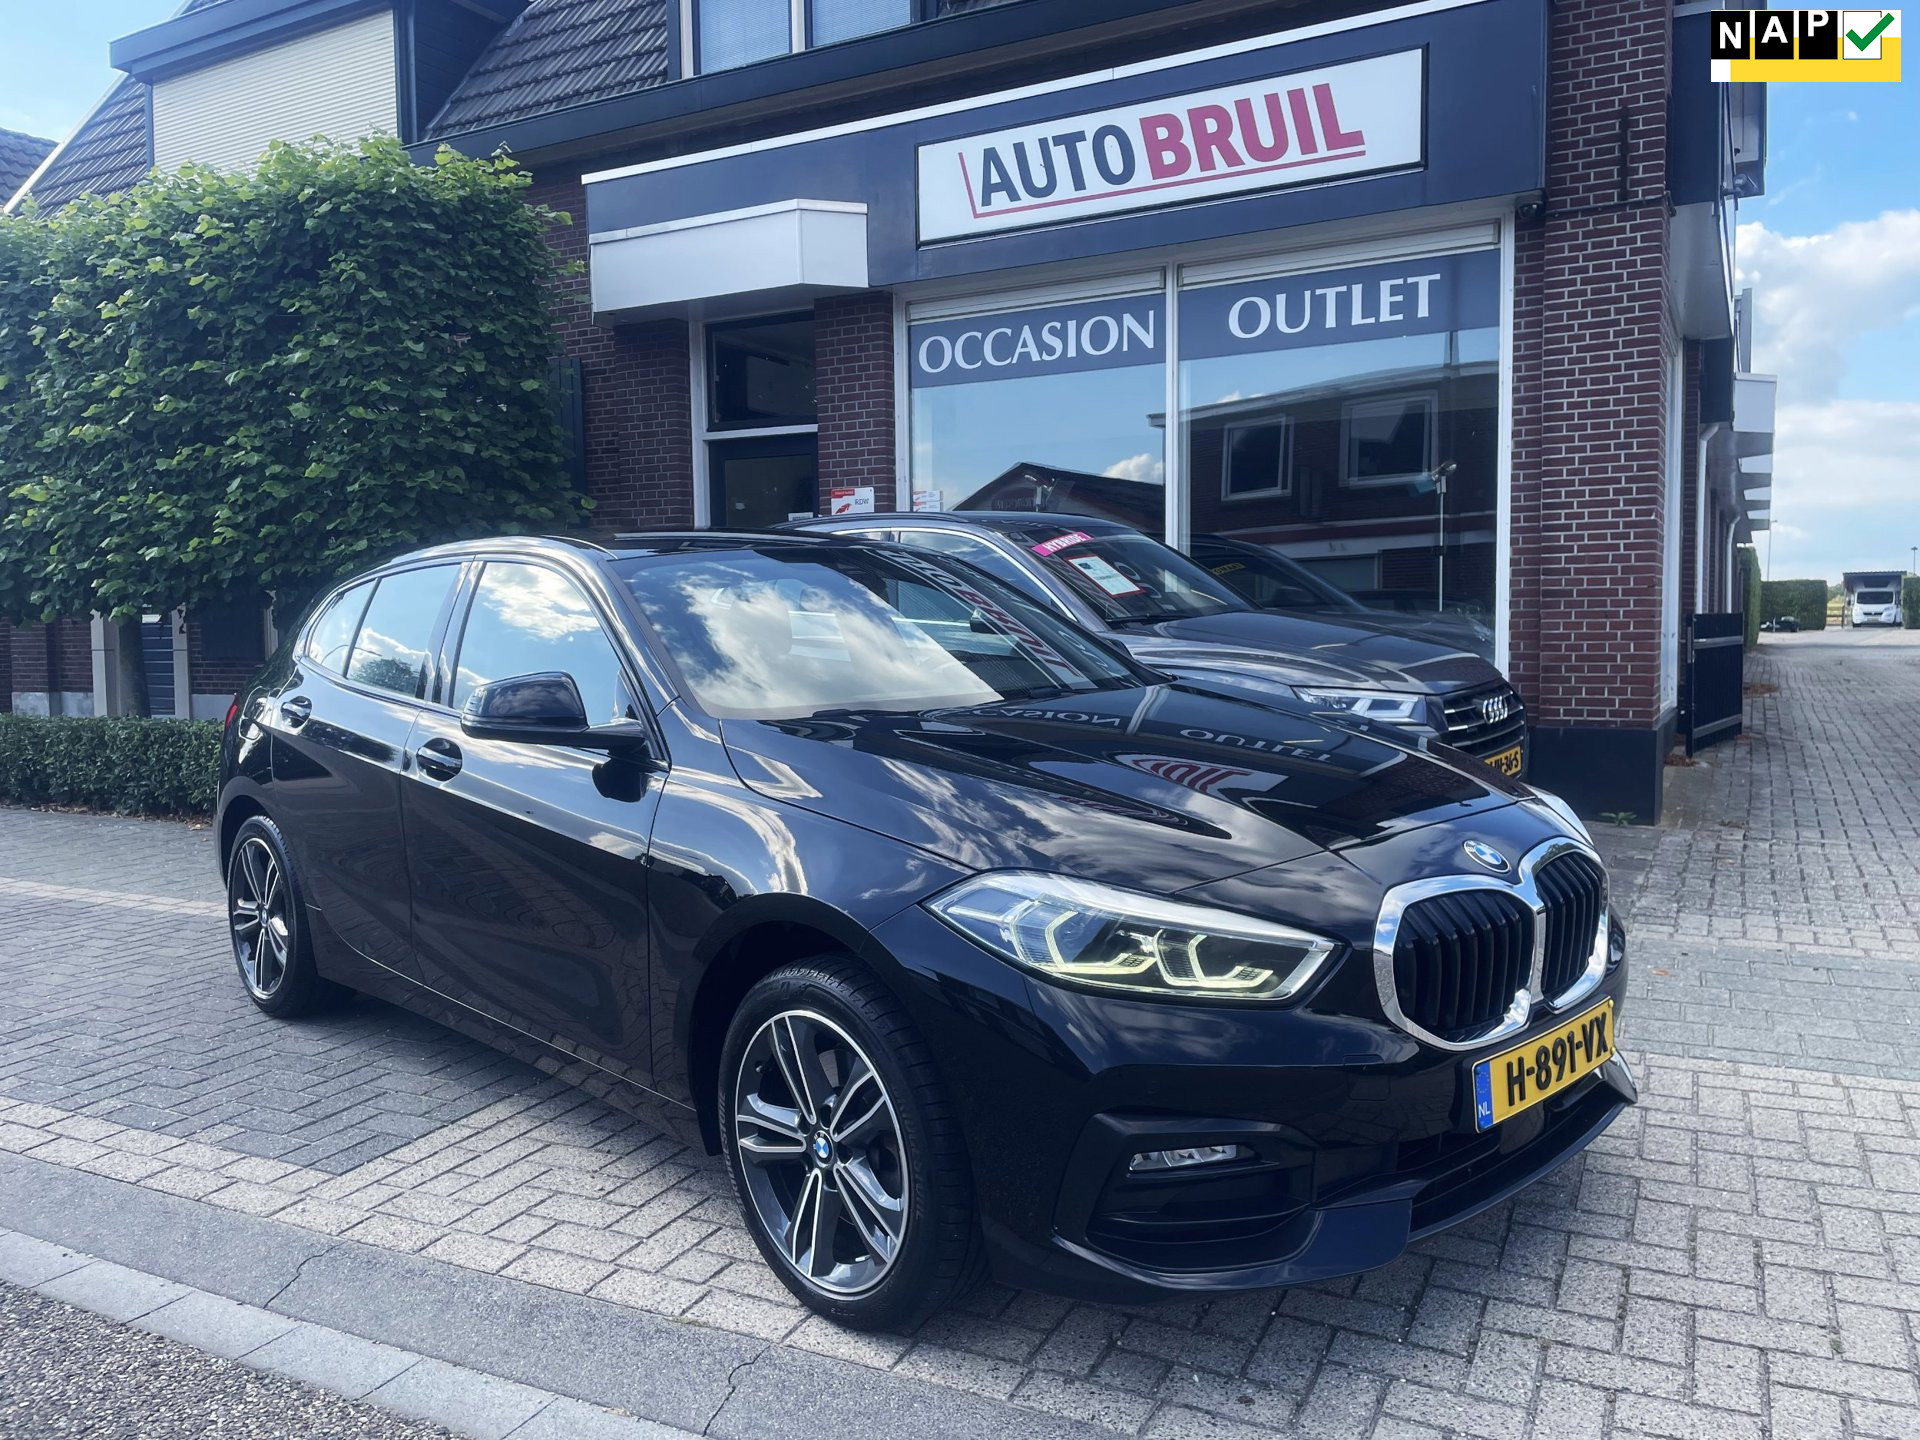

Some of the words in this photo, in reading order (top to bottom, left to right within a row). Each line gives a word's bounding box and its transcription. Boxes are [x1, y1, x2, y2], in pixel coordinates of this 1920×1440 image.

[918, 310, 1156, 374] OCCASION
[1228, 273, 1441, 338] OUTLET
[1507, 1012, 1609, 1107] H-891-VX
[1478, 1101, 1491, 1118] NL
